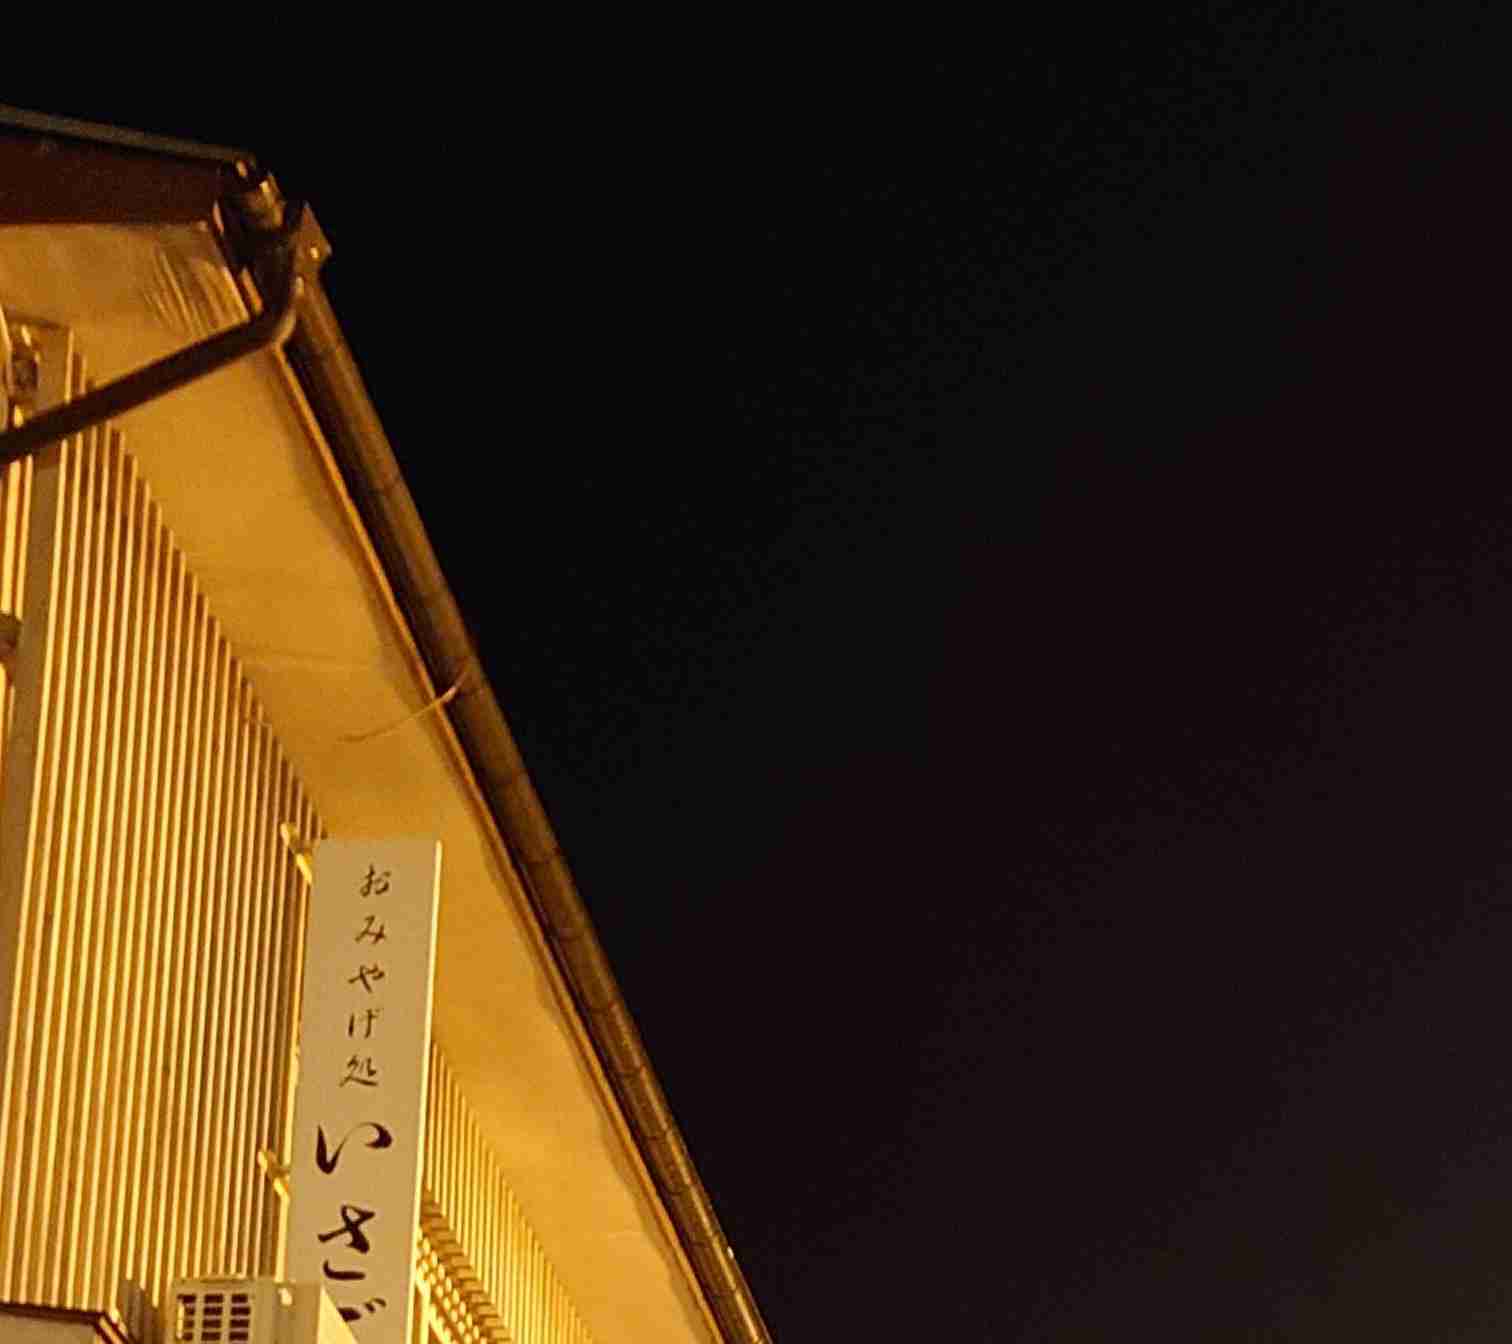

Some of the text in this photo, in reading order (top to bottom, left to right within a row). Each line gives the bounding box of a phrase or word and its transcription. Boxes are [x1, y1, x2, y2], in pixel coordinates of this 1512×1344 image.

[338, 863, 391, 1088] おみやげ処
